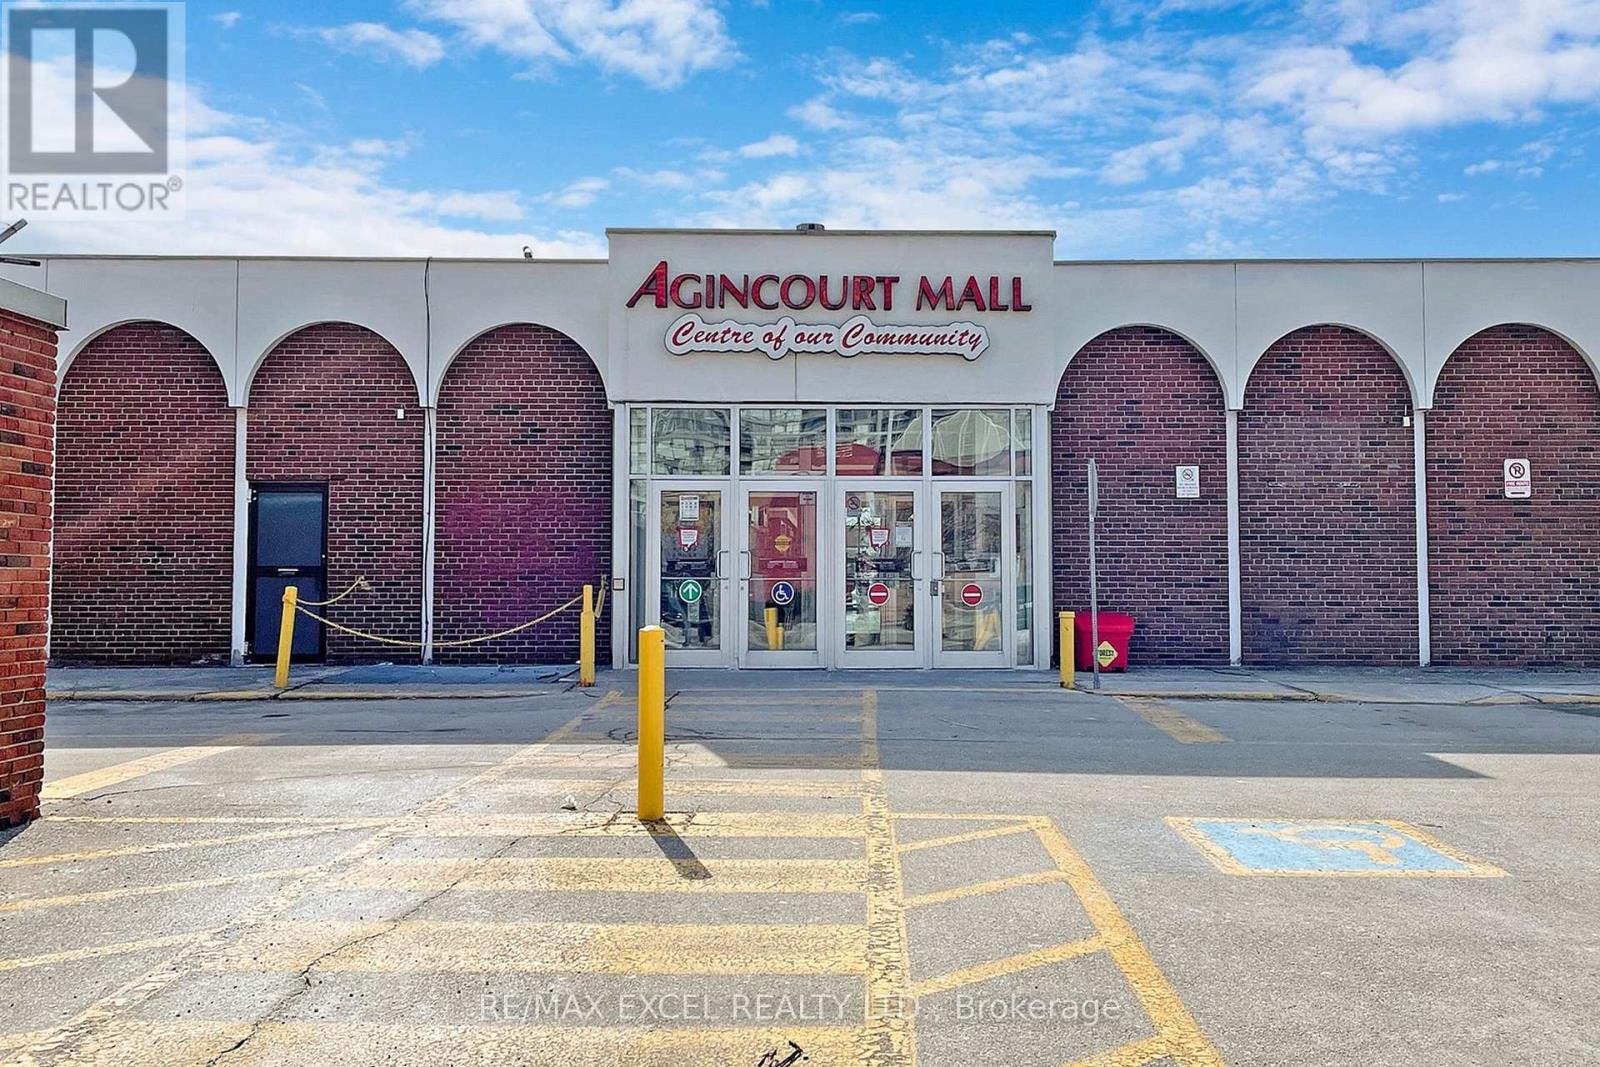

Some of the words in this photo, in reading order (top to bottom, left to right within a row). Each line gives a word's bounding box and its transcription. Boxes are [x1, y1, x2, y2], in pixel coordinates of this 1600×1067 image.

[625, 260, 900, 311] AGINCOURT
[916, 275, 1033, 312] MALL
[671, 319, 754, 347] Centre
[762, 319, 788, 355] of
[794, 326, 834, 346] our
[841, 323, 984, 351] Community
